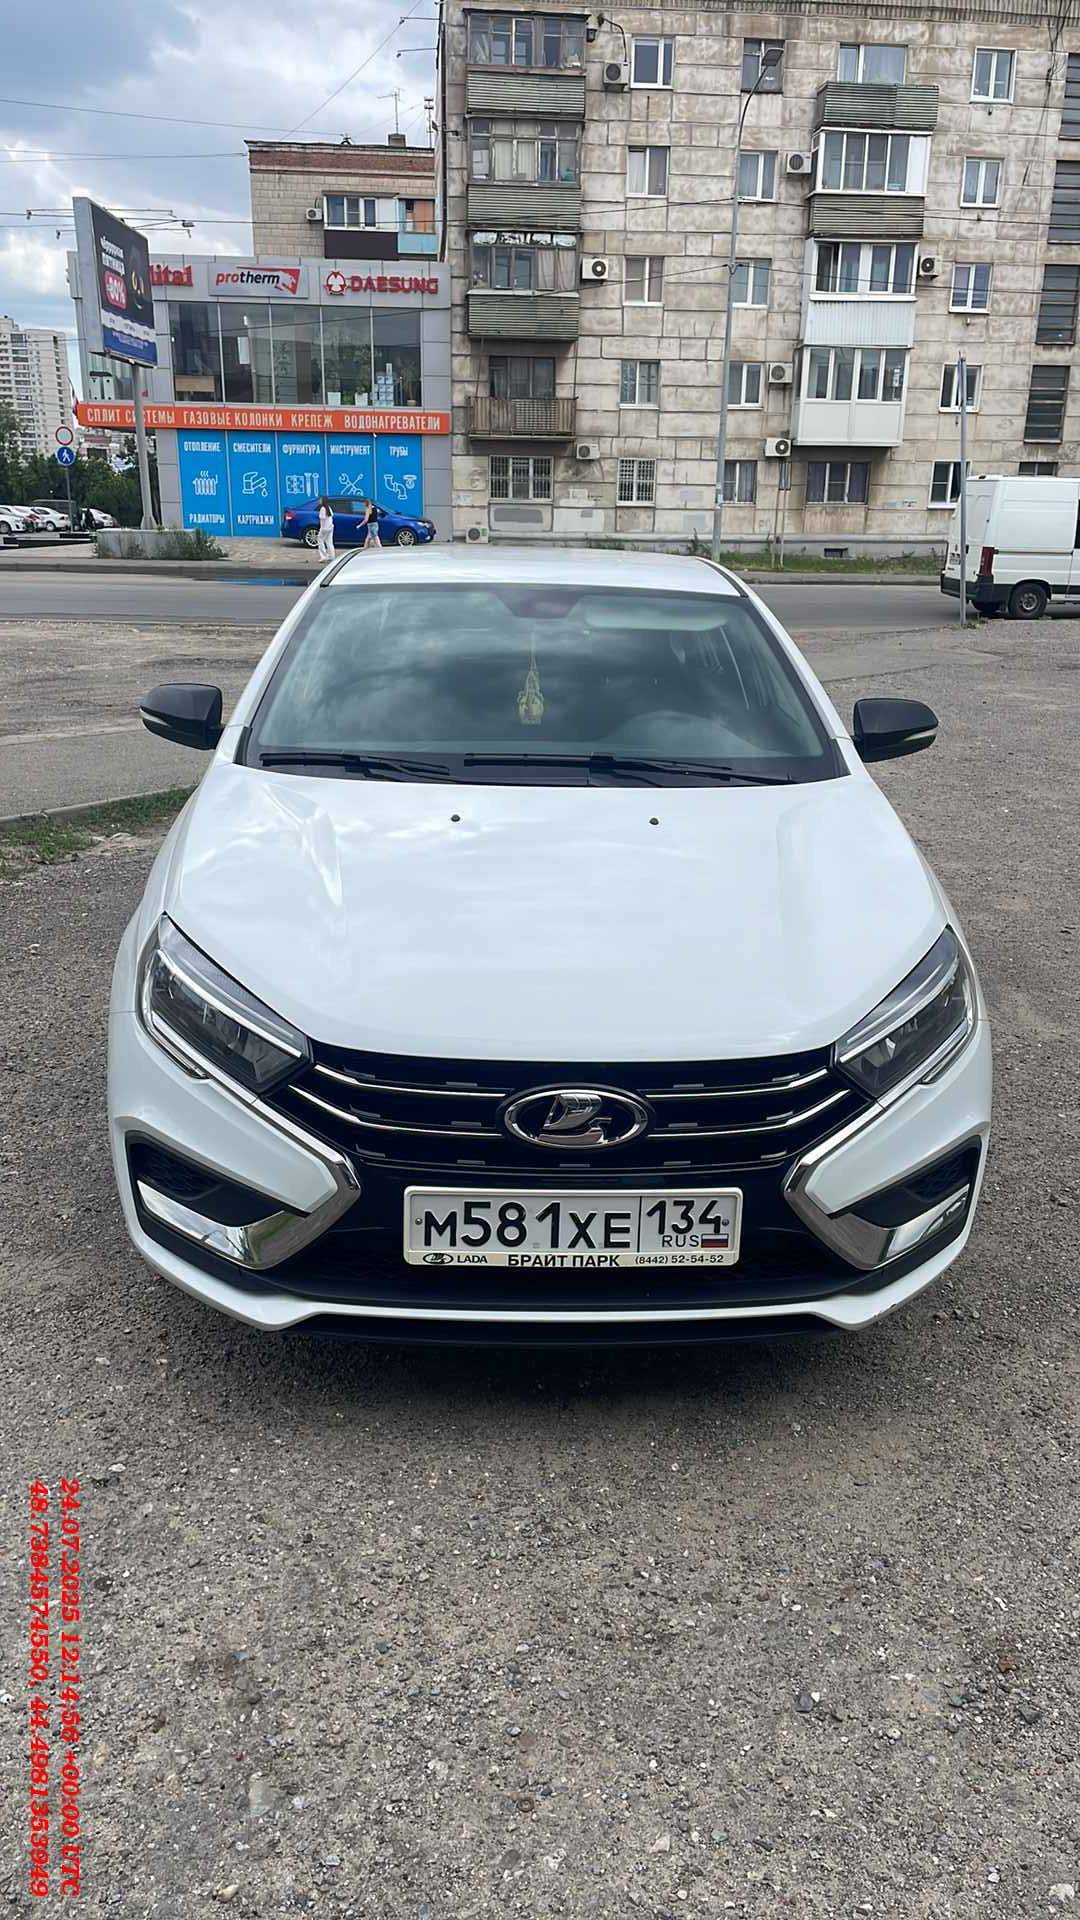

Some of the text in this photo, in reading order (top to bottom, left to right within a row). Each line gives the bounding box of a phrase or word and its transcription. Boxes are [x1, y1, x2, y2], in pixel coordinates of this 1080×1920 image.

[215, 269, 280, 286] protherm
[351, 275, 440, 294] DAESUNG
[87, 408, 441, 431] СПЛИТ СТЕМЫ ГАЗОВЫЕ КОЛОНКИ КРЕПЕЖ ВОДОНАГРЕВАТЕЛИ
[183, 441, 221, 452] ОТОПЛЕНИЕ
[233, 443, 271, 453] СМЕСИТЕЛИ
[282, 444, 320, 455] ФУРНИТУРА
[330, 445, 371, 456] ИНСТРУМЕНТ
[389, 446, 409, 457] ТРУБЫ
[189, 513, 225, 524] РАДИАТОРЫ
[237, 514, 274, 525] КАРТРИДЖИ
[646, 1199, 722, 1235] 134
[662, 1235, 699, 1248] RUS
[457, 1255, 488, 1264] LADA
[507, 1254, 620, 1267] БРАЙТ ПАРК
[635, 1254, 724, 1265] (8442) 52-54-52
